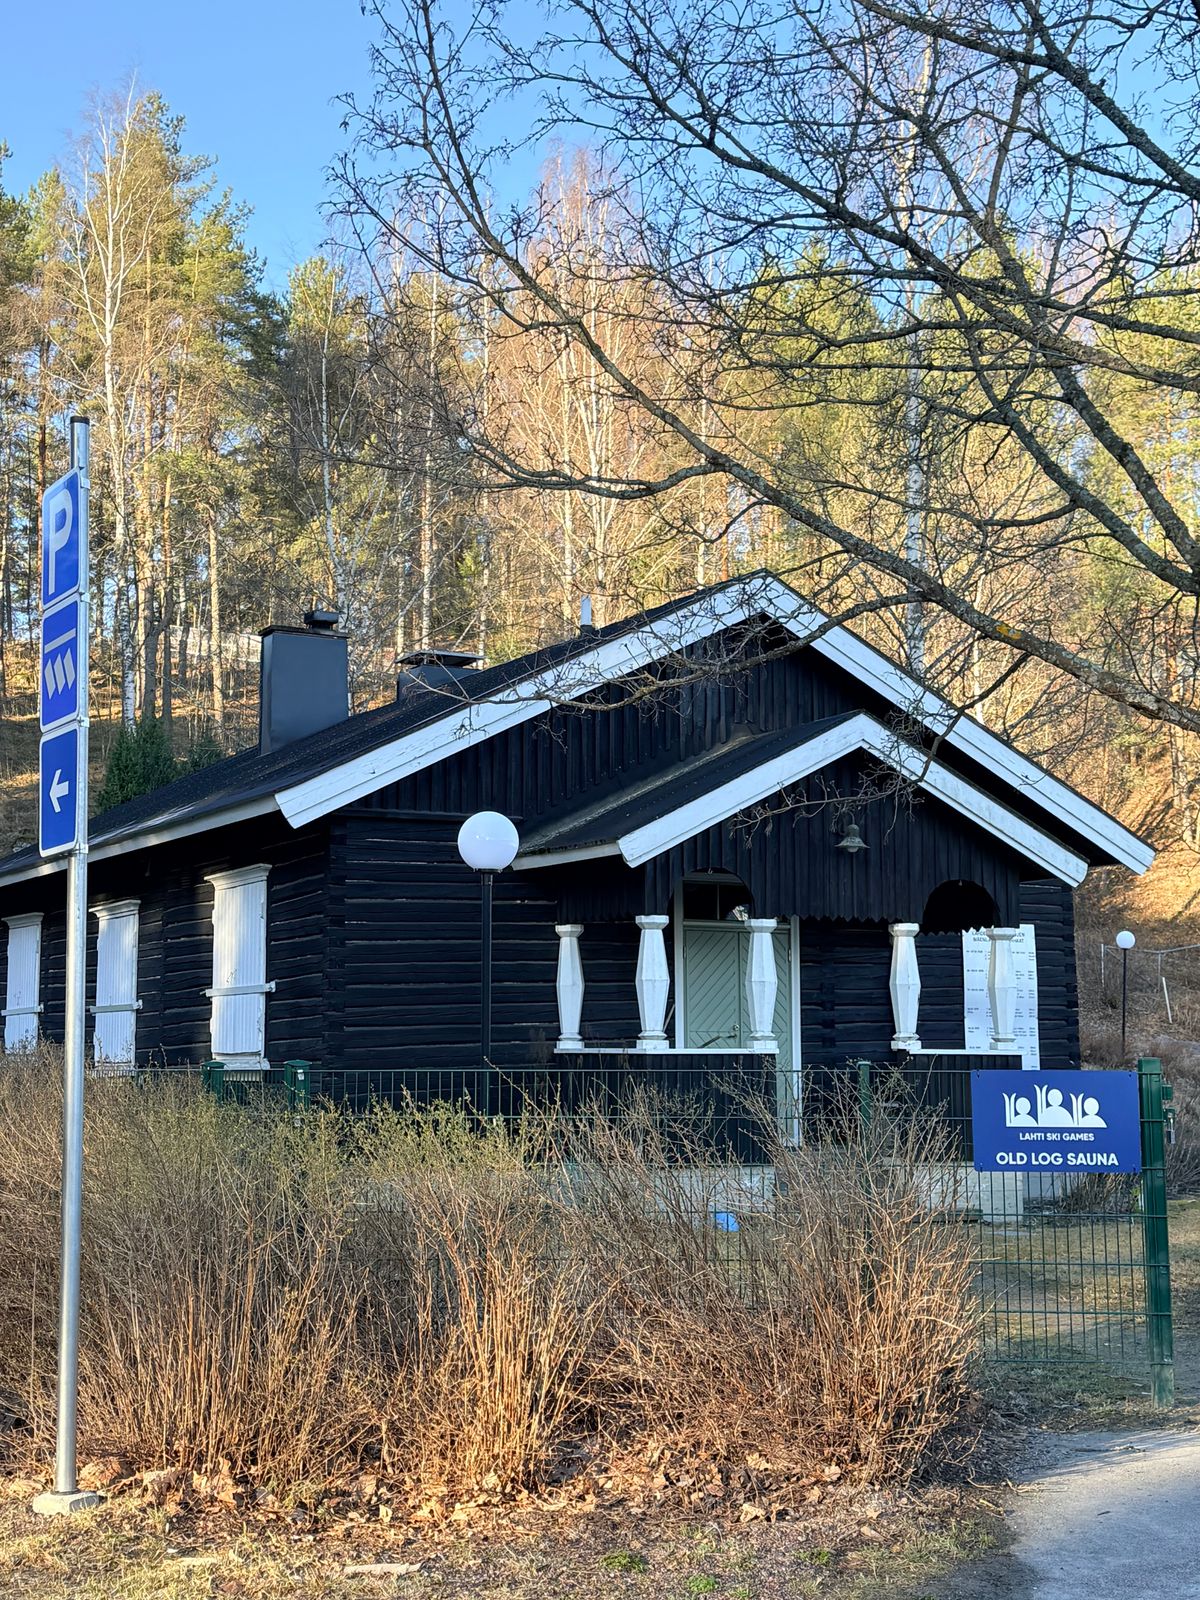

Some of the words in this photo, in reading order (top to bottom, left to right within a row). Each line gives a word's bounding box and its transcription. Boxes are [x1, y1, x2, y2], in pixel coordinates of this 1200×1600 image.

[48, 488, 73, 595] P
[1019, 1133, 1044, 1141] LAHTI
[1046, 1133, 1060, 1141] SKI
[1062, 1133, 1094, 1141] GAMES
[996, 1152, 1027, 1165] OLD
[1031, 1152, 1063, 1165] LOG
[1067, 1153, 1119, 1166] SAUNA
